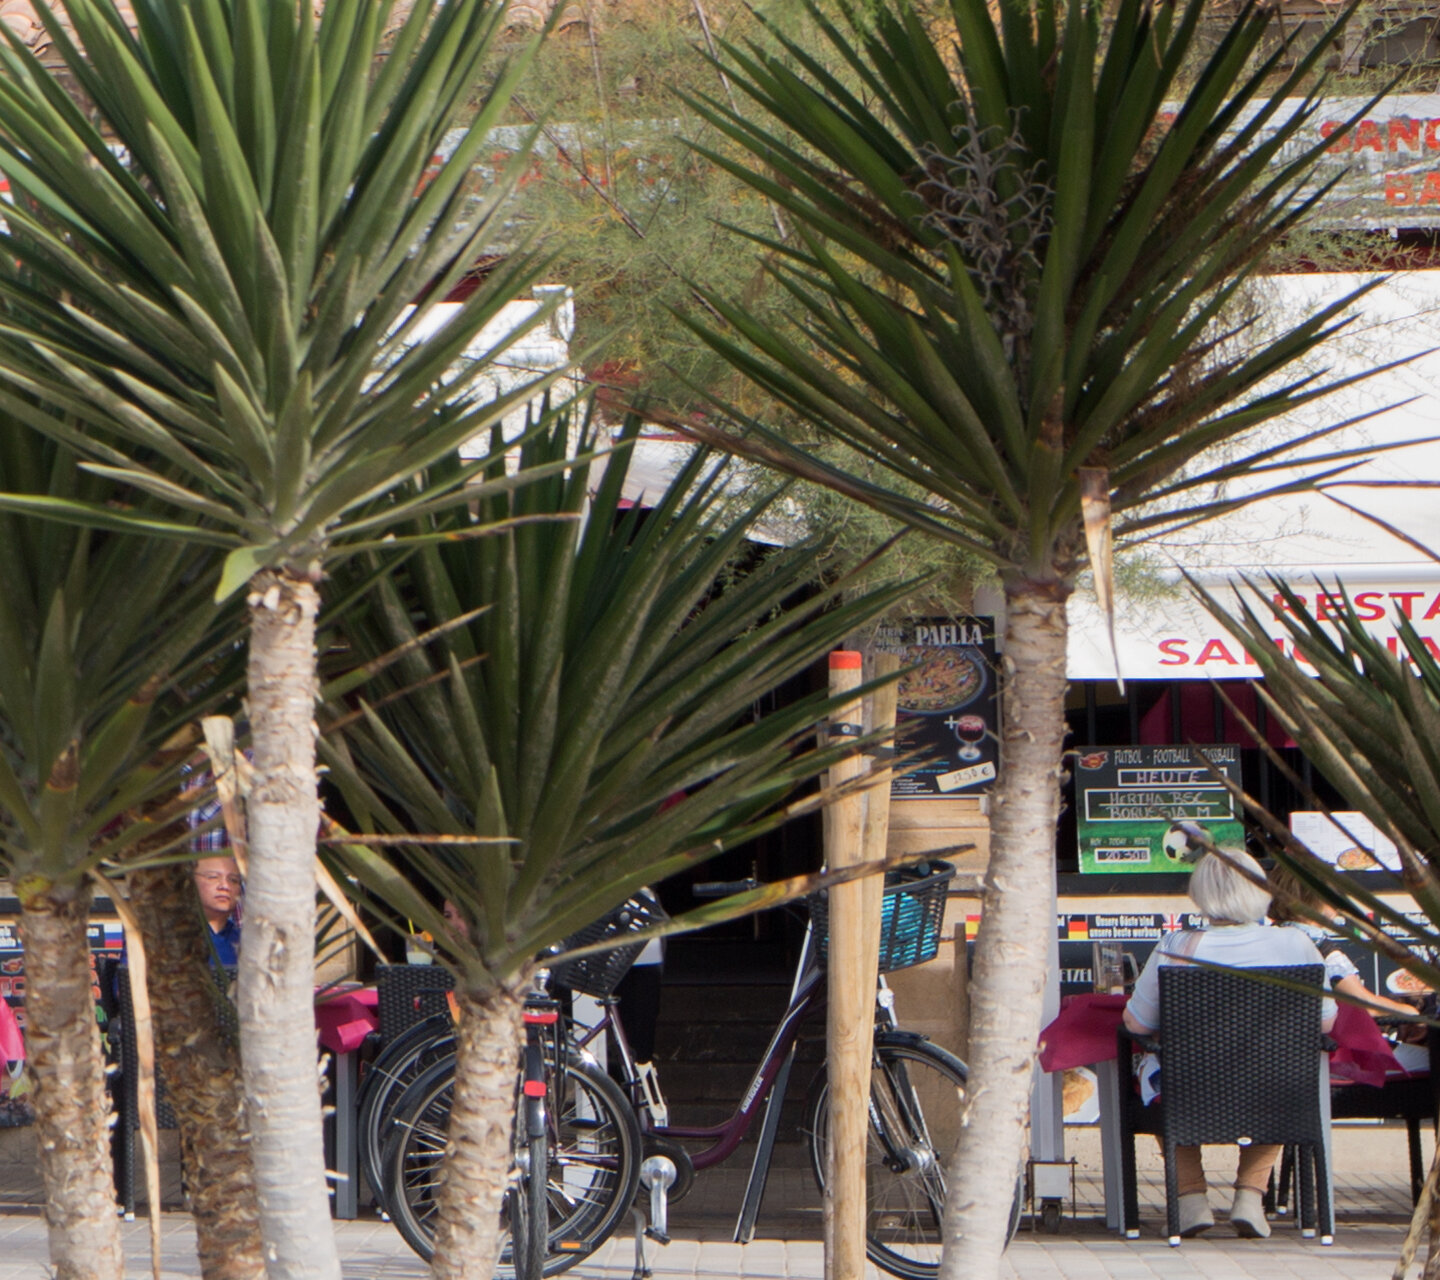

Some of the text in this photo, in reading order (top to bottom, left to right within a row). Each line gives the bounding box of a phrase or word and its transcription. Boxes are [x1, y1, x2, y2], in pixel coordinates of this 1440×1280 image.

[915, 624, 984, 646] PAELLA
[1153, 748, 1191, 764] FOOTBALL
[1136, 770, 1200, 783] HEUTE
[1196, 806, 1211, 818] M
